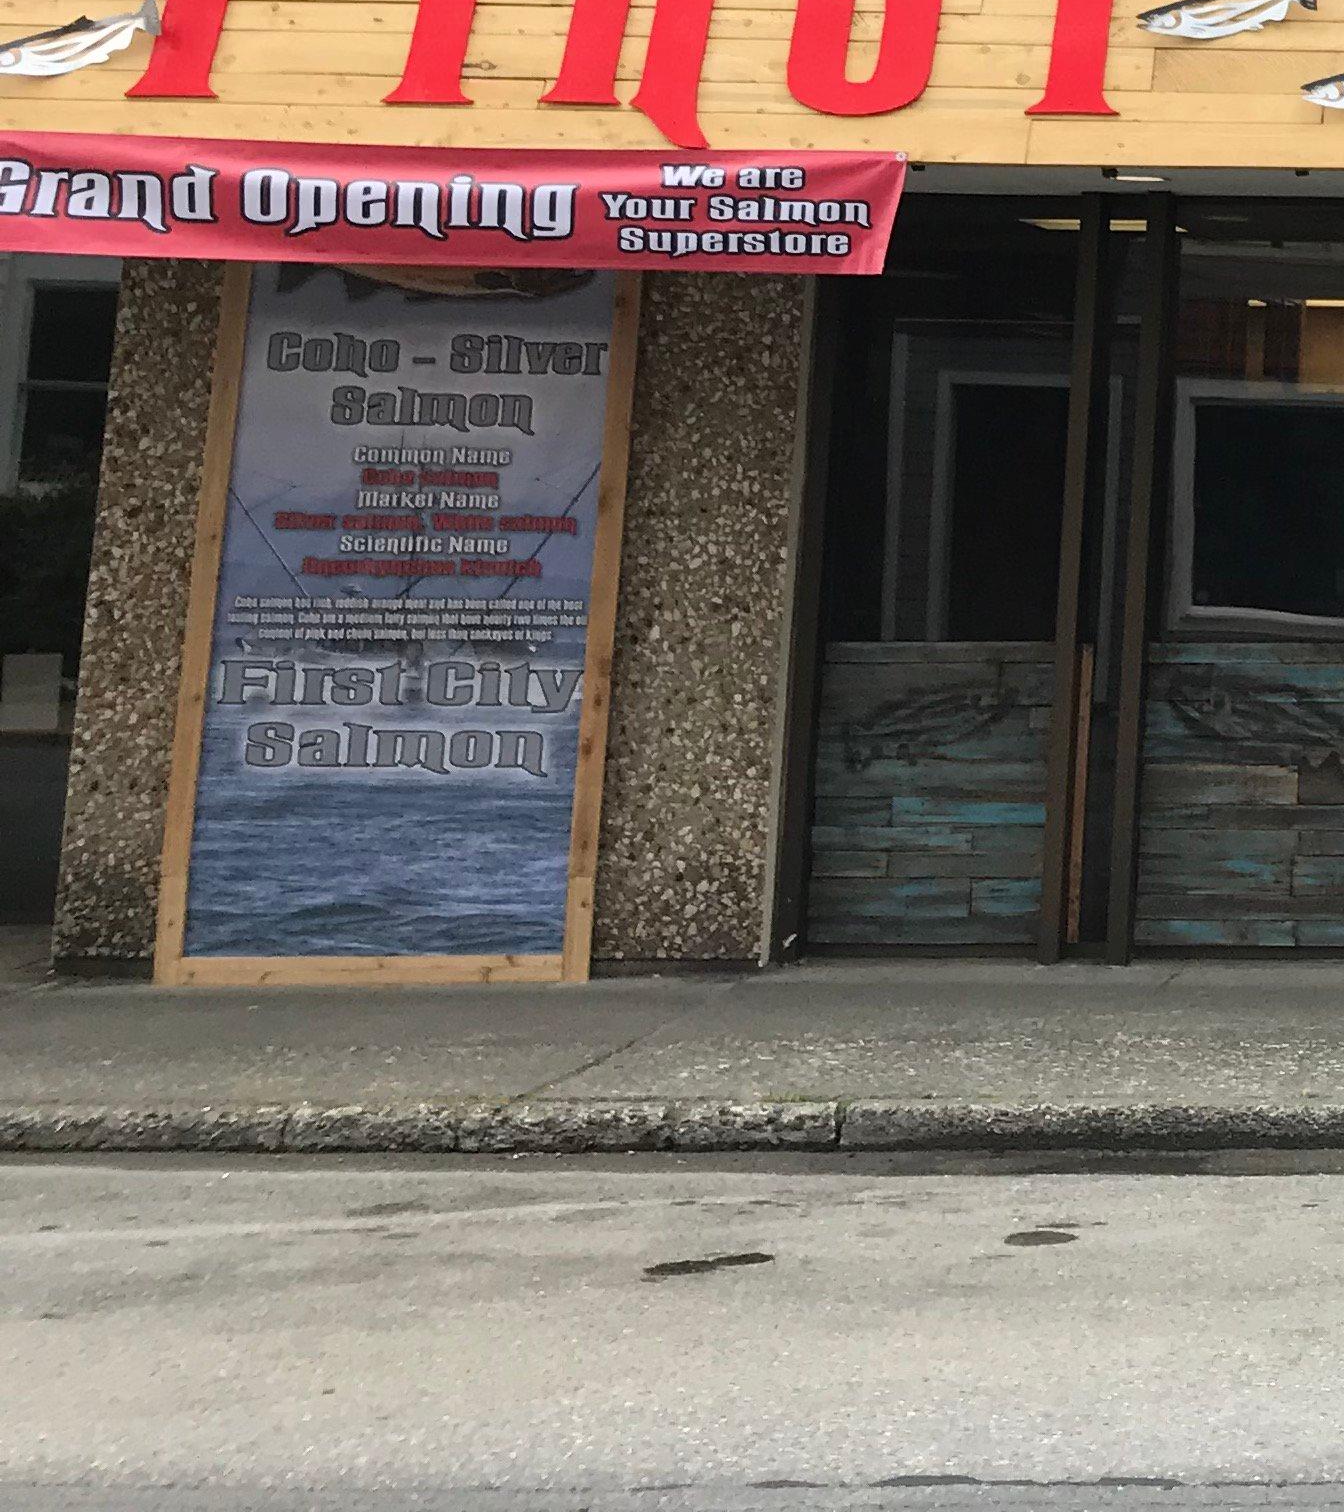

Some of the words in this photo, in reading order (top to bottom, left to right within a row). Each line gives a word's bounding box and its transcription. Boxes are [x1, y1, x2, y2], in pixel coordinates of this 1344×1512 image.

[661, 164, 726, 188] We
[738, 165, 805, 189] are
[0, 157, 219, 233] Grand
[241, 167, 581, 239] Opening
[599, 192, 698, 221] Your
[708, 194, 871, 228] Salmon
[618, 225, 851, 257] Superstore
[267, 331, 400, 378] Coho
[449, 333, 608, 376] Silver
[330, 385, 535, 436] Salmon
[353, 445, 445, 466] Common
[451, 446, 511, 466] Name
[357, 490, 434, 509] Market
[439, 491, 500, 510] Name
[339, 534, 442, 554] Scientific
[449, 535, 509, 555] Name
[218, 660, 407, 706] First
[426, 660, 585, 714] City
[245, 721, 547, 777] Salmon
